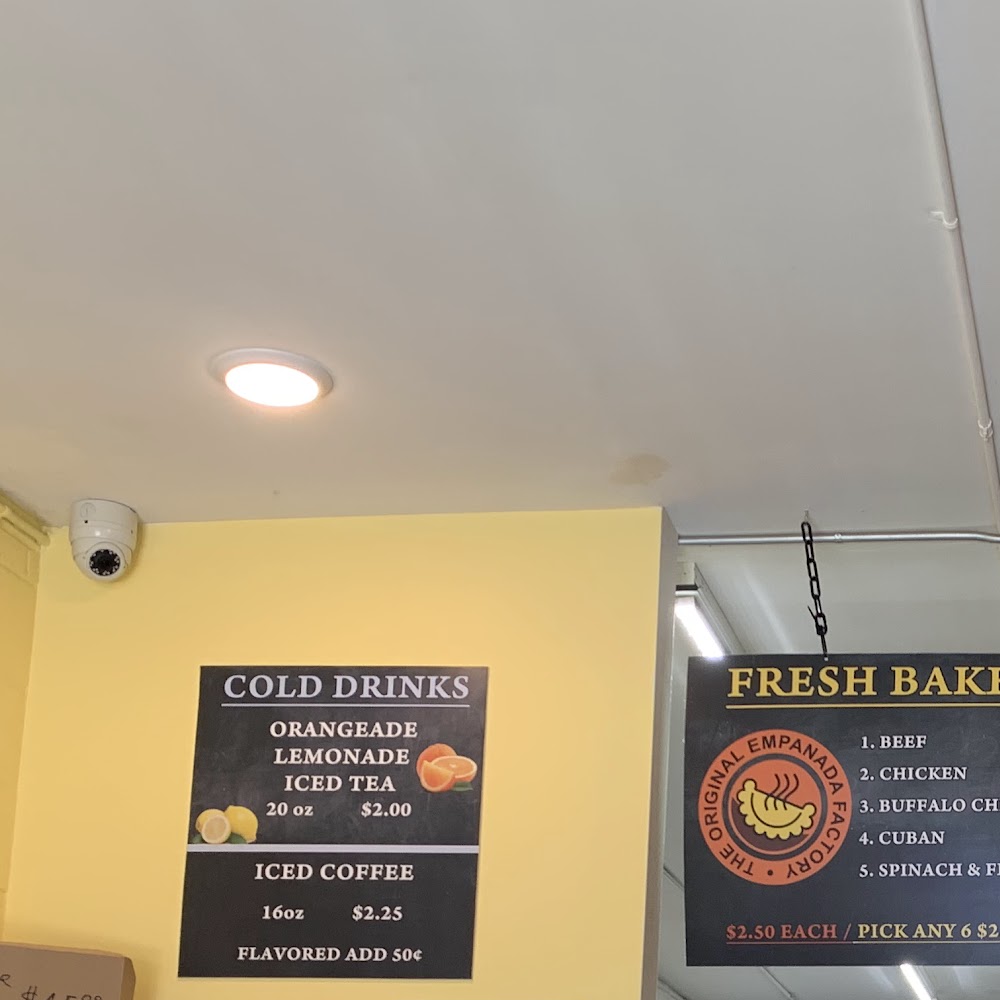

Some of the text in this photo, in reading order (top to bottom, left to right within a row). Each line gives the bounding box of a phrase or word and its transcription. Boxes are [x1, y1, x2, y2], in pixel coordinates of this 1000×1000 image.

[223, 674, 470, 699] COLD DRINKS
[727, 666, 878, 698] FRESH
[269, 721, 418, 738] ORANGEADE
[860, 735, 927, 749] 1. BEEF
[273, 748, 410, 765] LEMONADE
[859, 767, 967, 781] 2. CHICKEN
[284, 775, 396, 792] ICED TEA
[266, 801, 412, 818] 20 oz $2.00
[704, 734, 847, 879] THE ORIGINAL EMPANADA FACTORY
[859, 800, 874, 814] 3.
[879, 799, 966, 813] BUFFALO
[858, 831, 945, 845] 4. CUBAN
[254, 863, 414, 881] ICED COFFEE
[858, 864, 873, 878] 5.
[878, 863, 963, 877] SPINACH
[967, 864, 981, 877] &
[262, 905, 403, 921] 16oz $2.25
[726, 924, 776, 940] $2.50
[780, 924, 837, 939] EACH
[843, 923, 852, 940] /
[858, 924, 911, 939] PICK
[912, 923, 957, 938] ANY
[961, 923, 972, 938] 6
[237, 946, 423, 962] FLAVORED ADD 50¢
